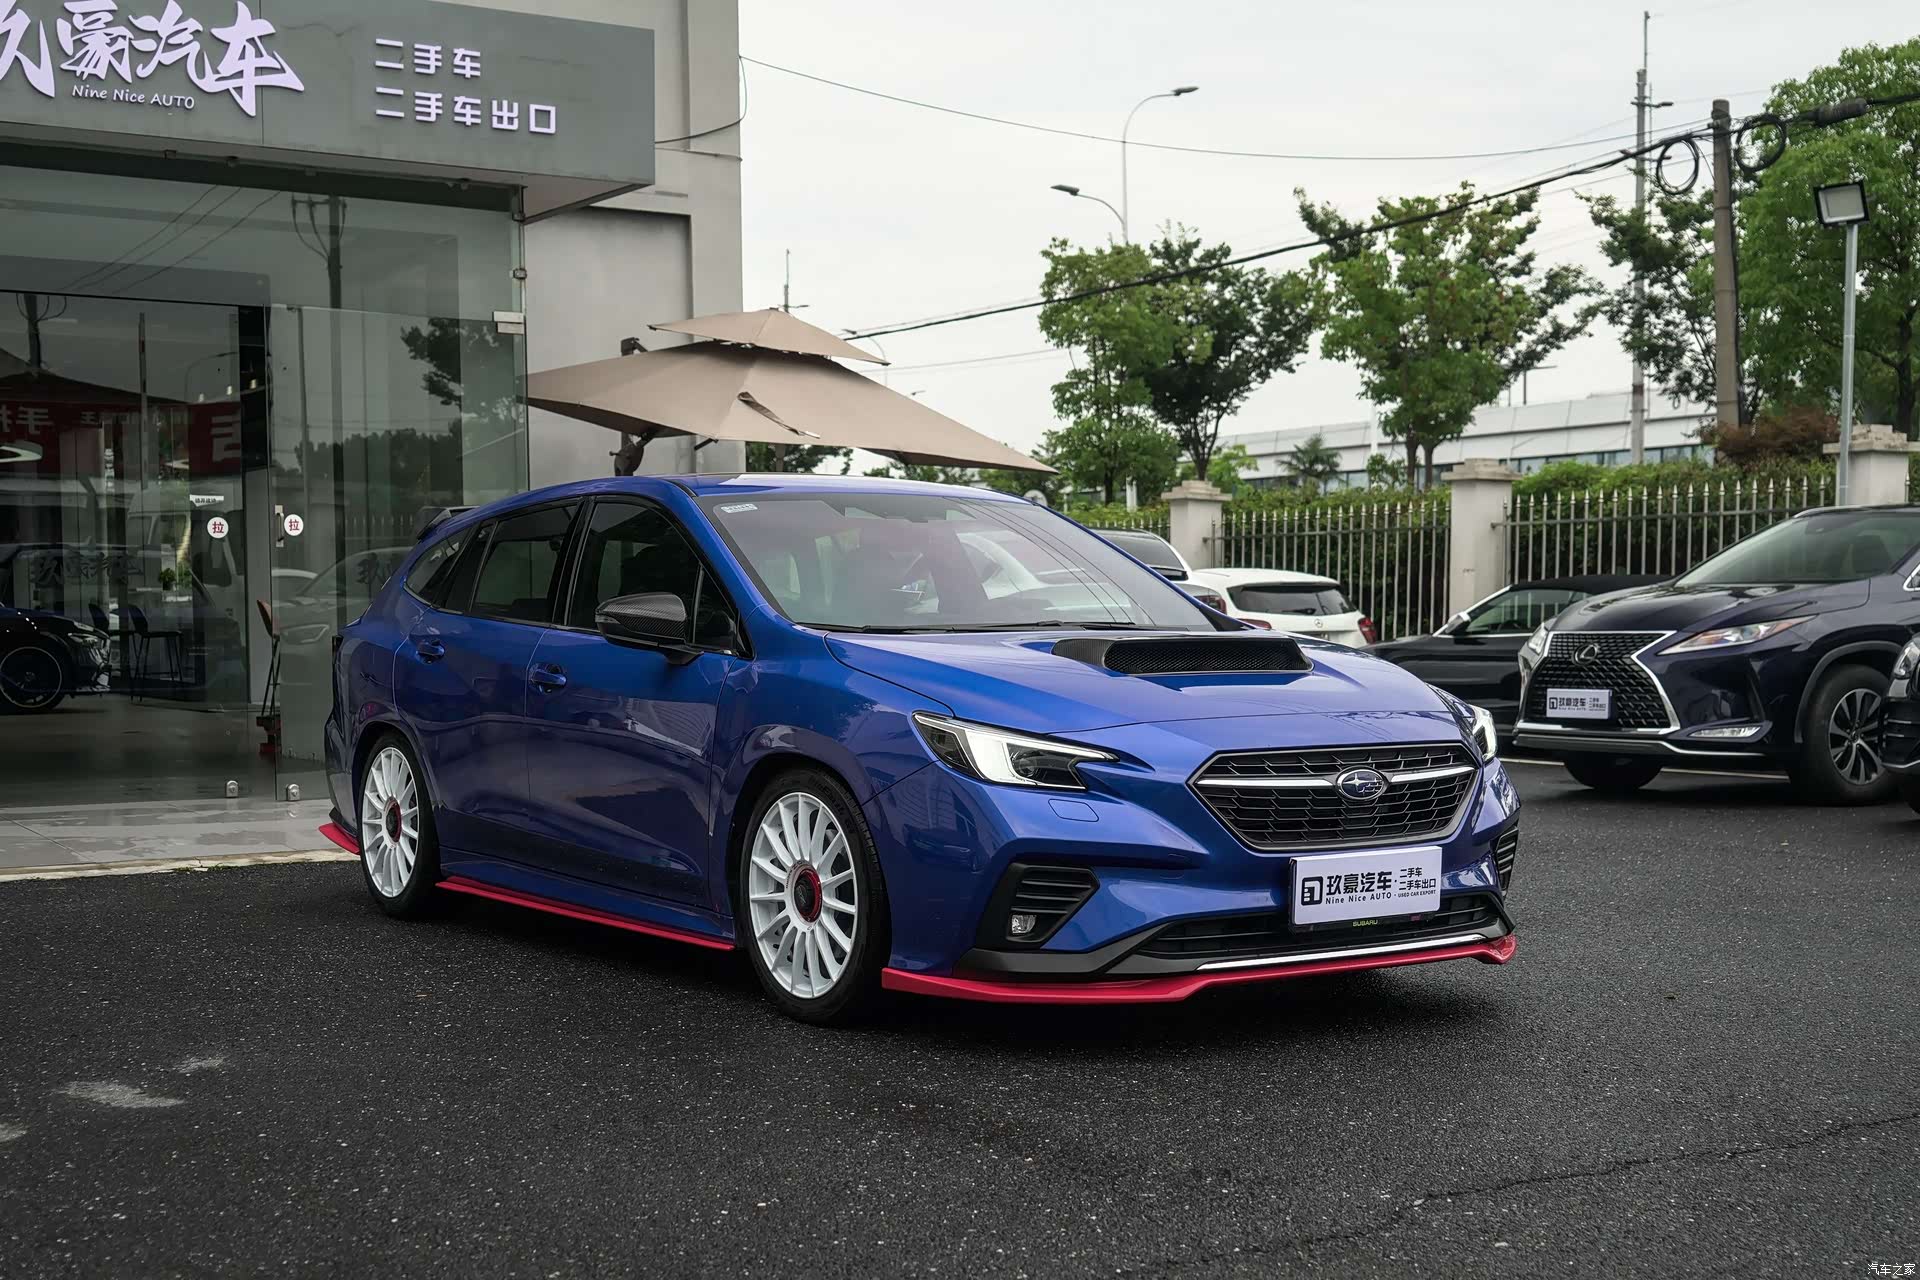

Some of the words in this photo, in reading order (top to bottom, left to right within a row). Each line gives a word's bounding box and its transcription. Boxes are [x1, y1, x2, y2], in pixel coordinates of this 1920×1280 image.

[375, 38, 481, 78] 二手车
[71, 84, 108, 100] Nine
[113, 88, 146, 104] Nice
[150, 92, 195, 110] AUTO
[375, 86, 556, 134] 二手车出口
[212, 521, 225, 534] 拉
[289, 519, 300, 532] 拉
[1399, 867, 1423, 878] 二手车
[1326, 871, 1393, 896] 玖豪汽车
[1399, 878, 1437, 891] 二手车出口
[1325, 897, 1345, 905] Nine
[1348, 895, 1367, 903] Nice
[1370, 892, 1392, 900] AUTO
[1352, 919, 1379, 927] SUBARU
